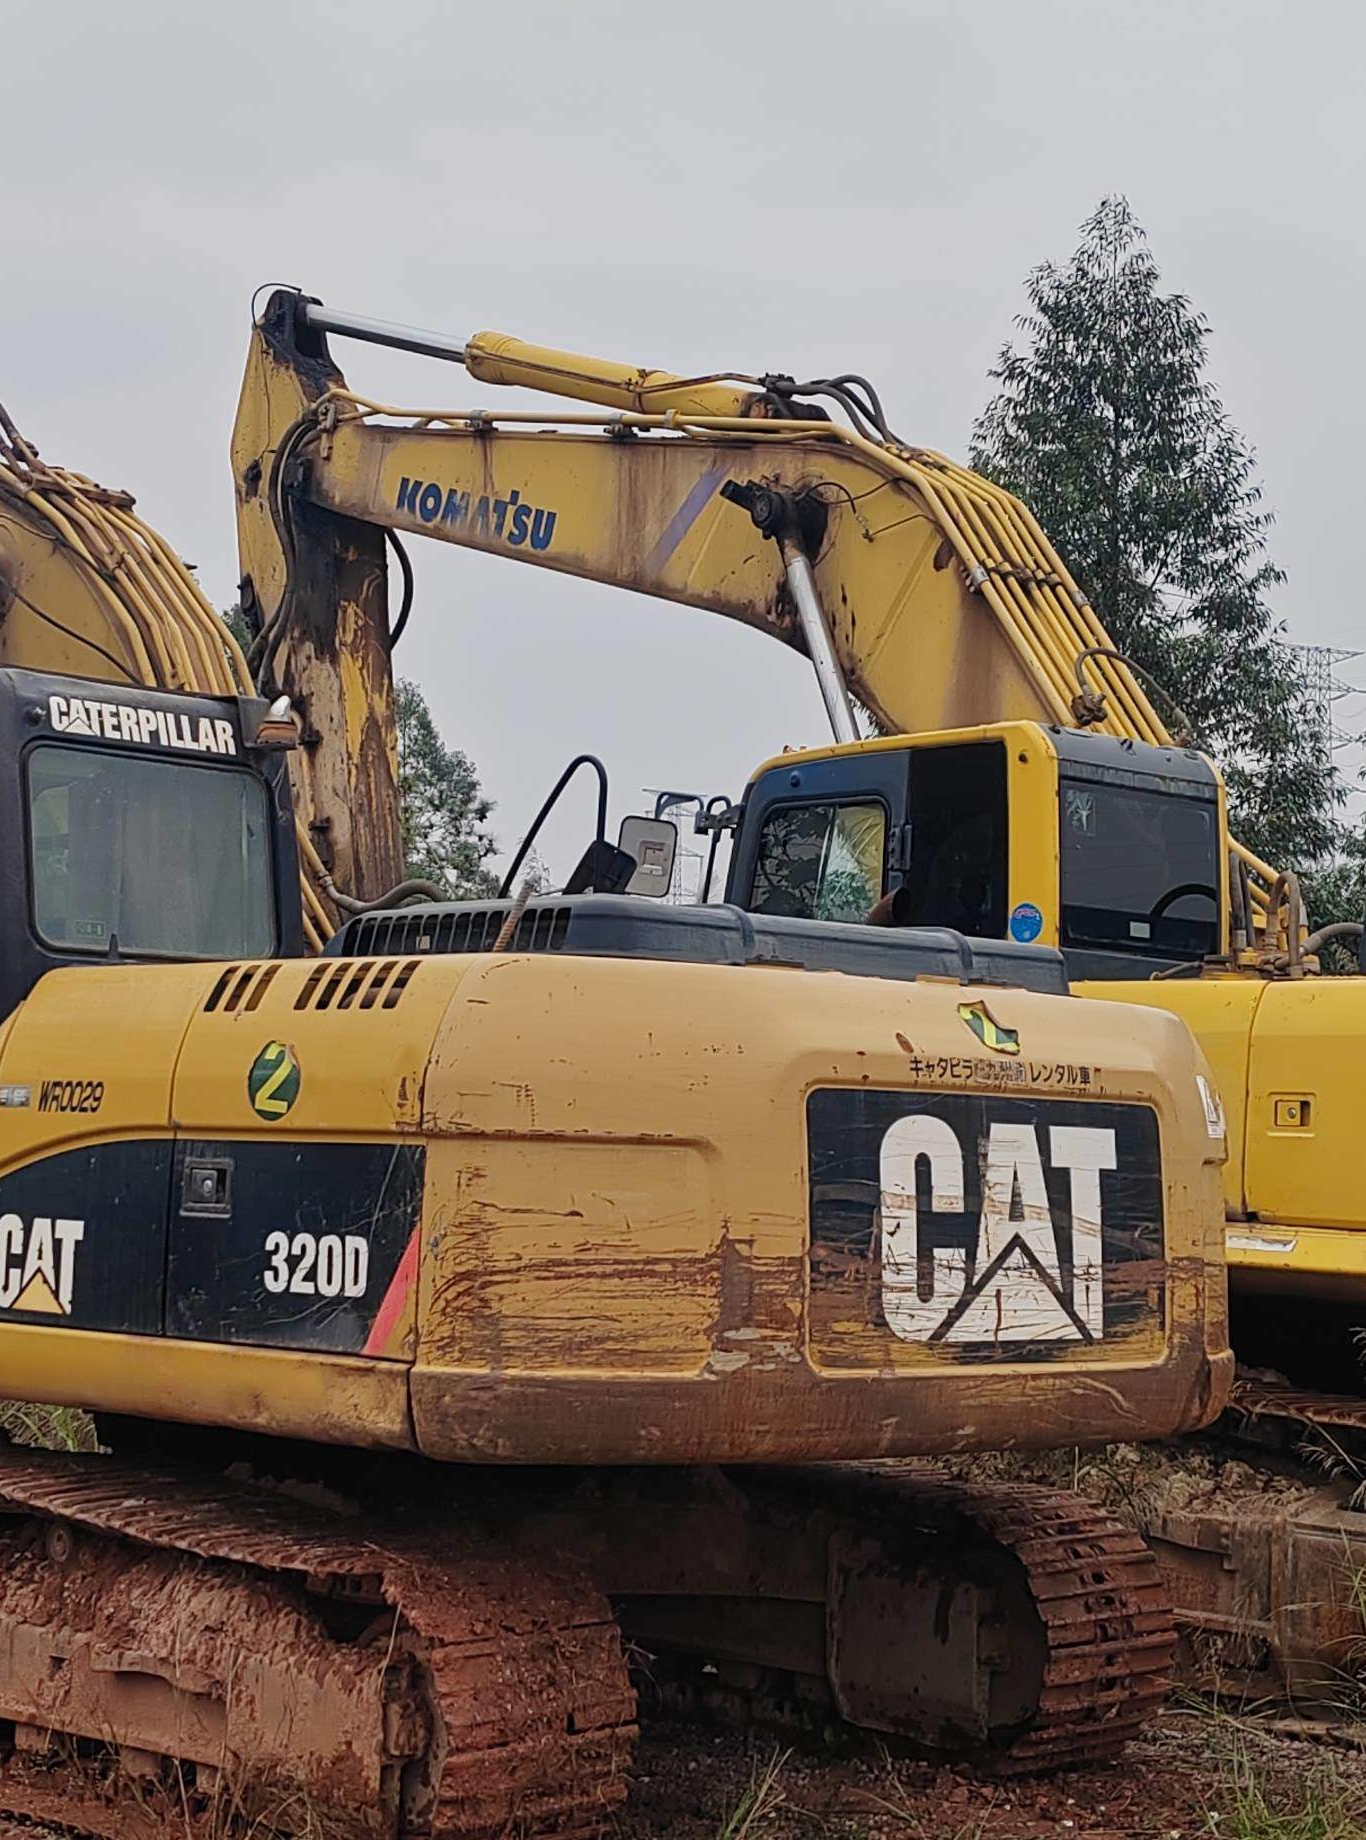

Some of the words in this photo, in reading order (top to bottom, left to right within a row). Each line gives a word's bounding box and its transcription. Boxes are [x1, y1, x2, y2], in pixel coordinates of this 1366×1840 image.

[396, 476, 557, 550] KOMATSU
[49, 695, 236, 755] CATERPILLAR
[38, 1080, 104, 1113] WR0029
[255, 1042, 293, 1113] 2
[879, 1114, 1118, 1343] CAT
[264, 1230, 368, 1298] 320D
